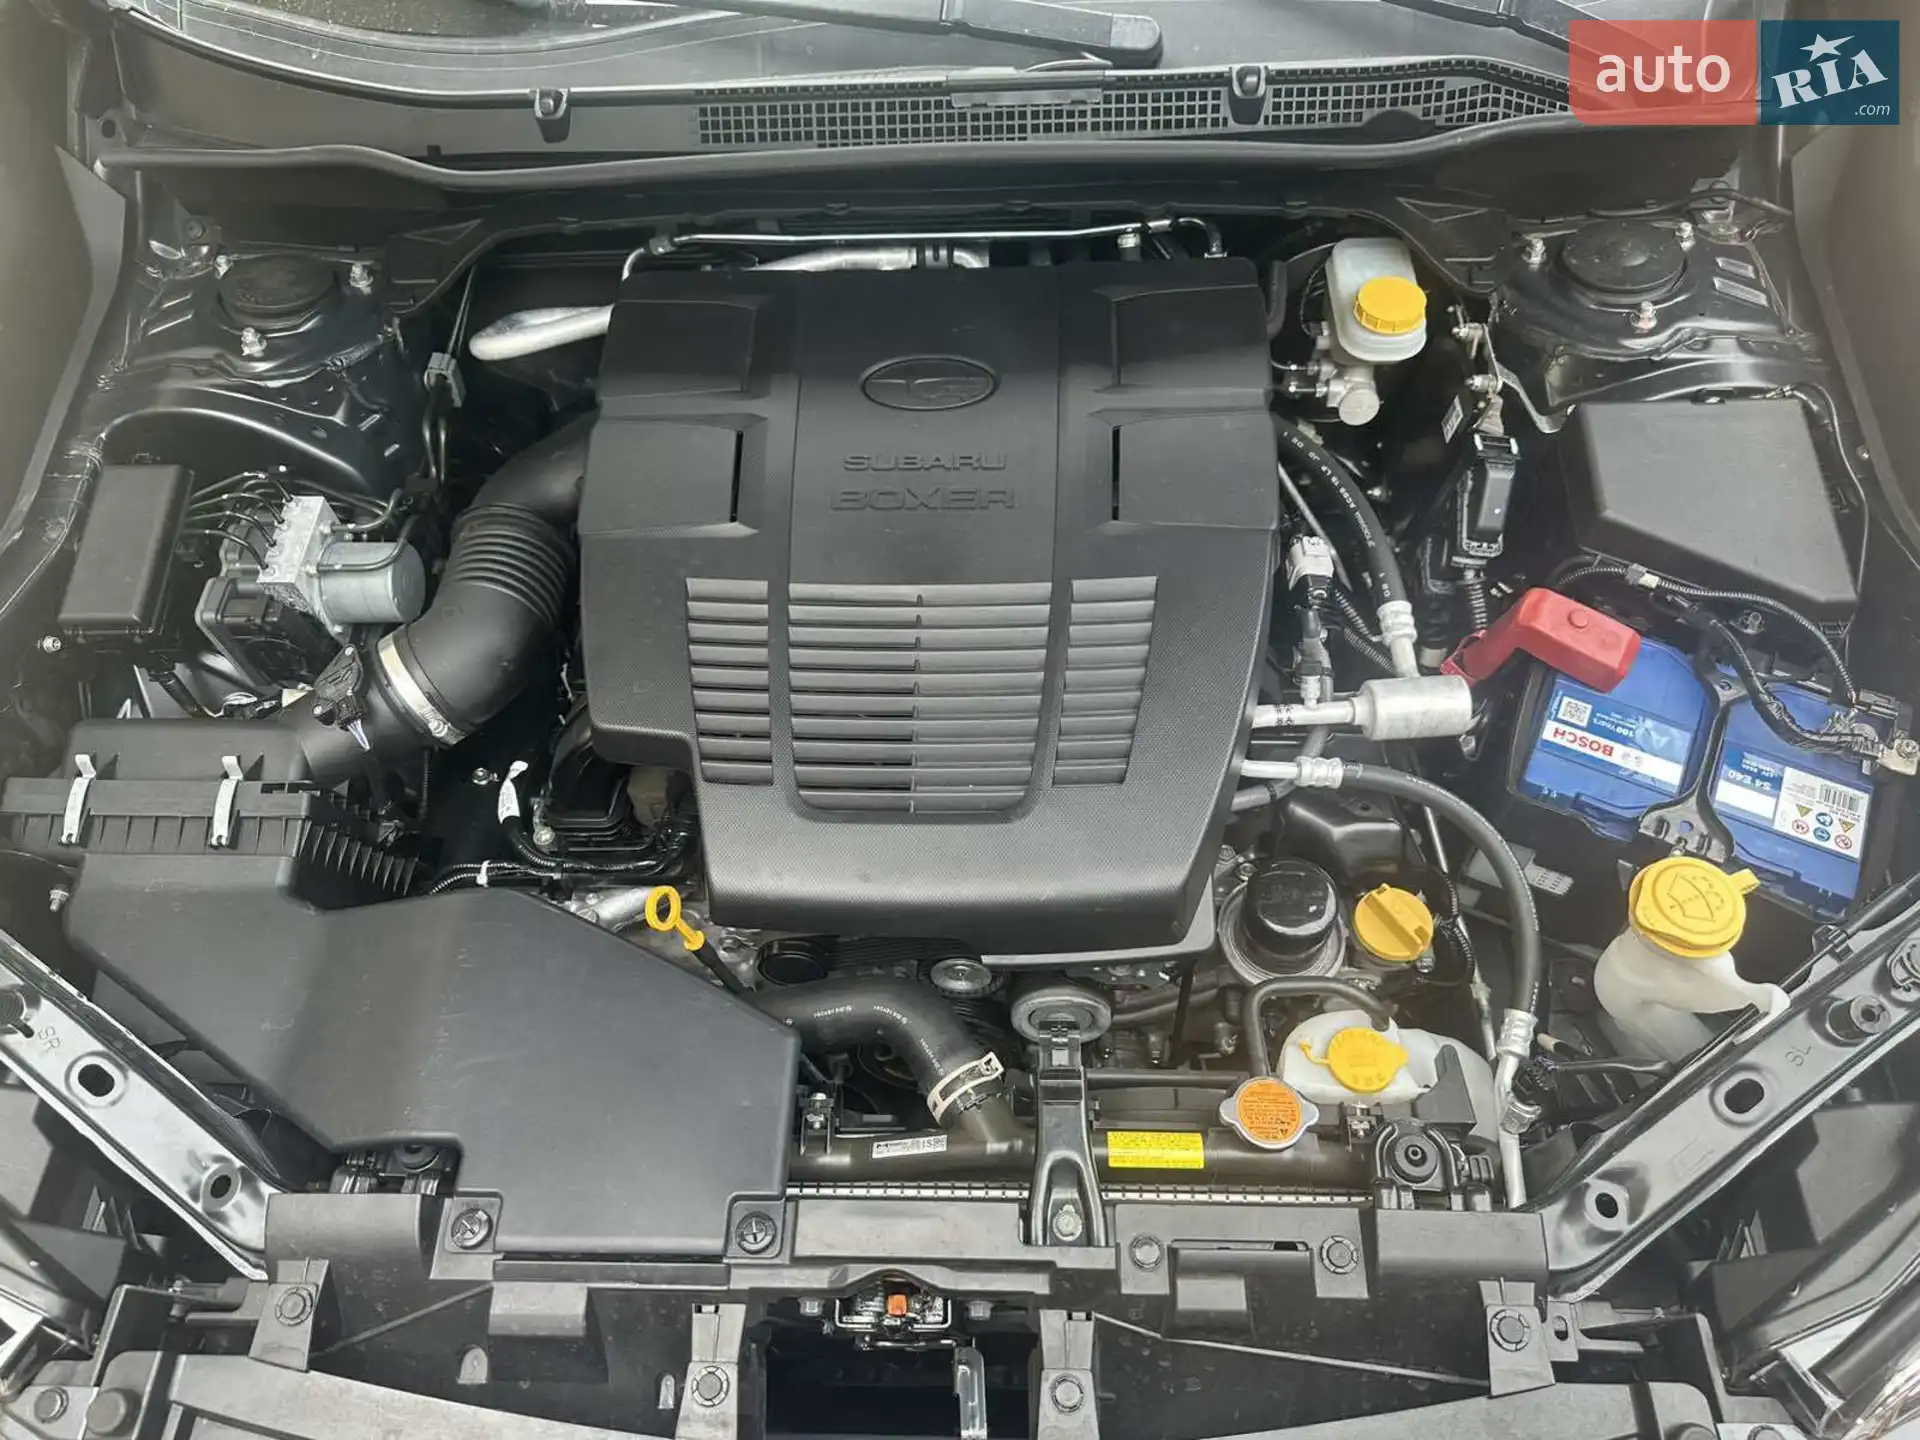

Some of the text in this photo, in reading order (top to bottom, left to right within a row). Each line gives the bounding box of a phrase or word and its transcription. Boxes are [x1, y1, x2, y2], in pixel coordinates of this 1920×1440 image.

[843, 453, 1007, 471] SUBARU
[830, 487, 1016, 511] BOXER
[1553, 727, 1615, 757] BOSCH
[1754, 779, 1773, 792] S4
